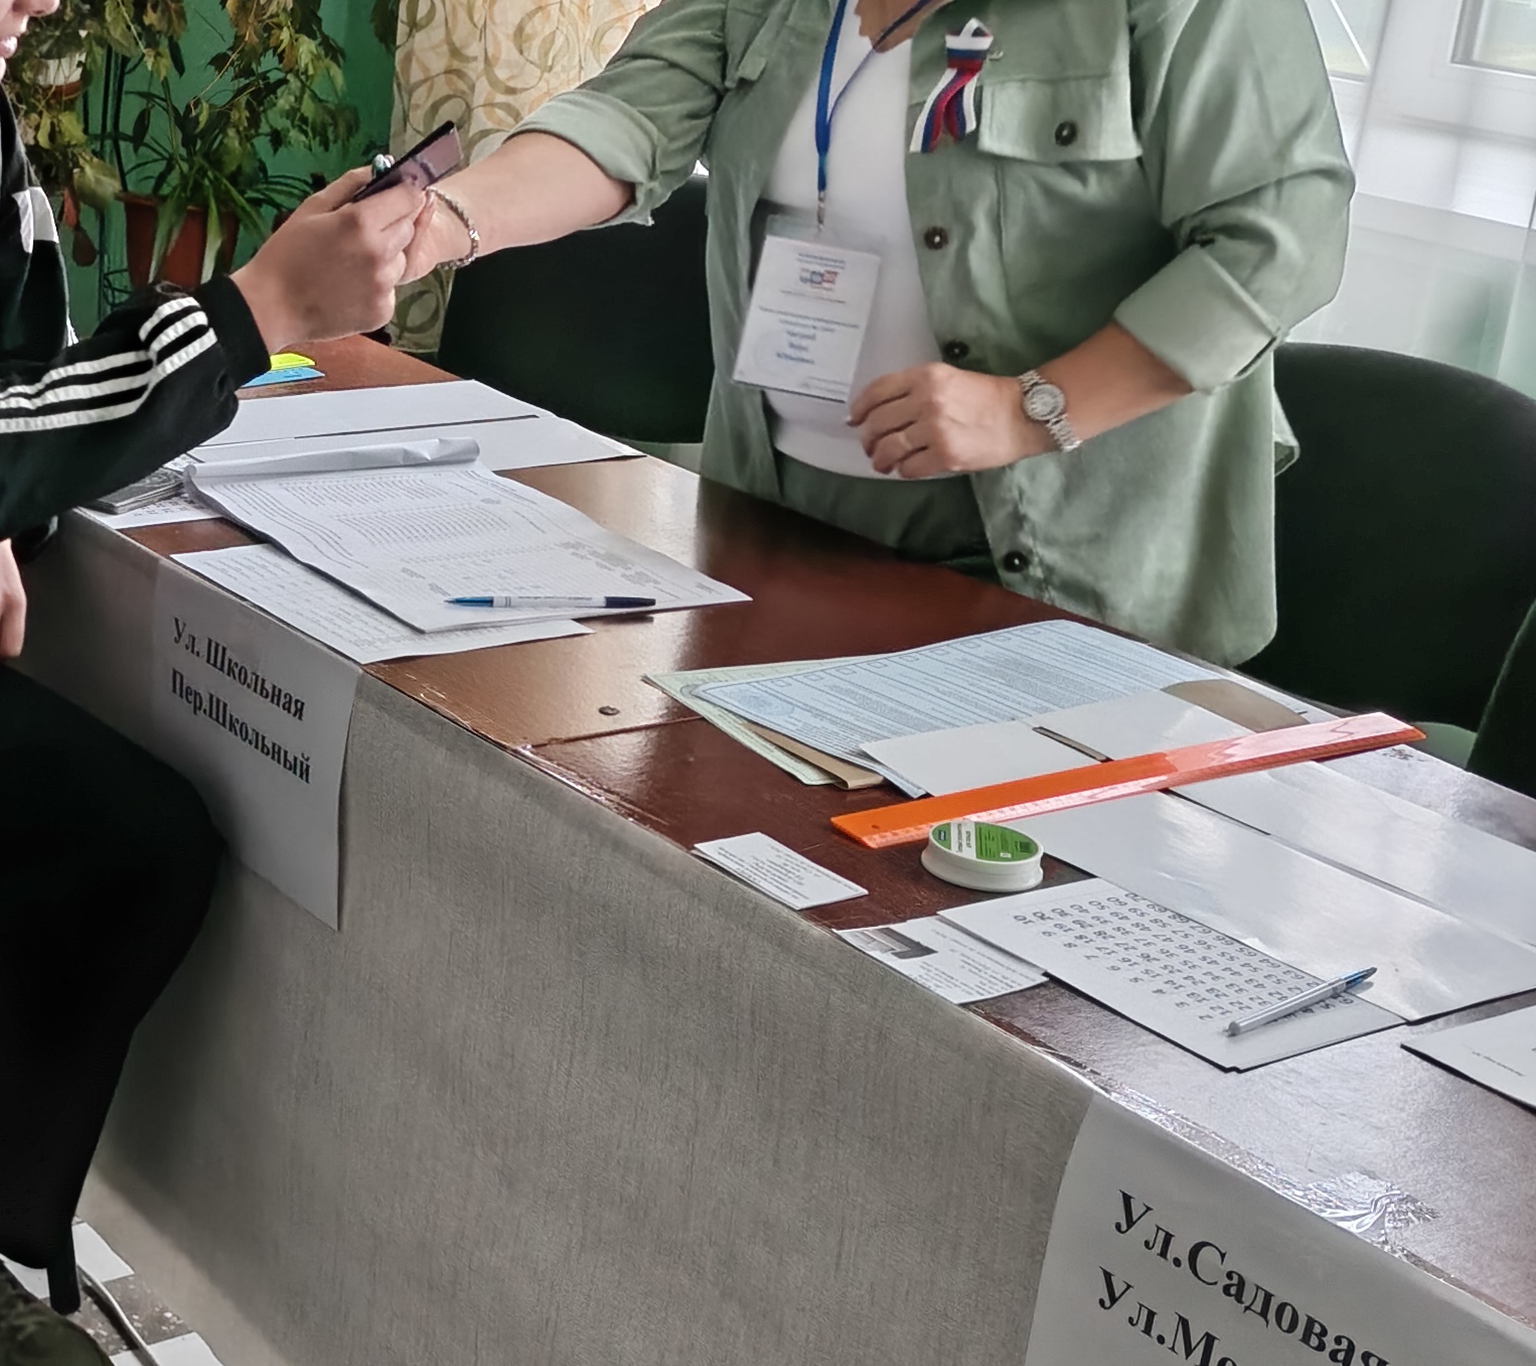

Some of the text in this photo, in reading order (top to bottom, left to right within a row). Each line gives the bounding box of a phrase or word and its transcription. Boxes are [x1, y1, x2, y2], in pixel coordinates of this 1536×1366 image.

[172, 616, 306, 721] Ул. Школьная
[171, 668, 312, 785] Пер.Школьный
